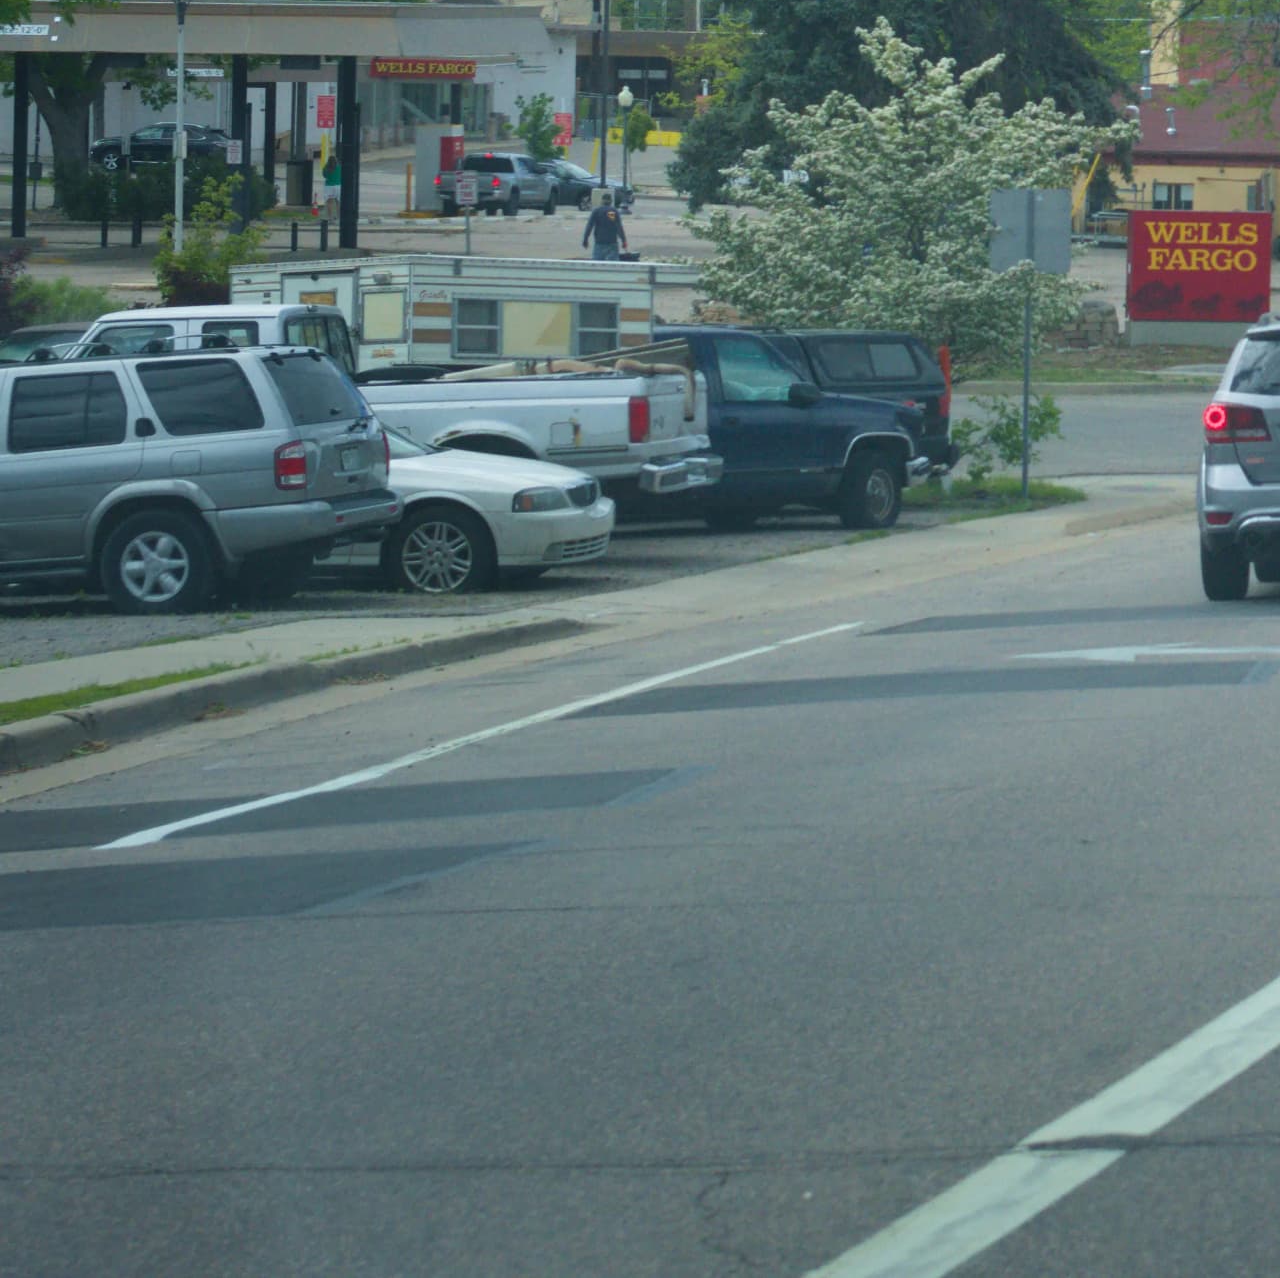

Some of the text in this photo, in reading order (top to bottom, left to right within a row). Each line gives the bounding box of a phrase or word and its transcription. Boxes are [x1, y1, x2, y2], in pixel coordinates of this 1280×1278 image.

[376, 62, 476, 75] WELLS FARGO
[1145, 221, 1259, 246] WELLS
[1146, 247, 1258, 272] FARGO
